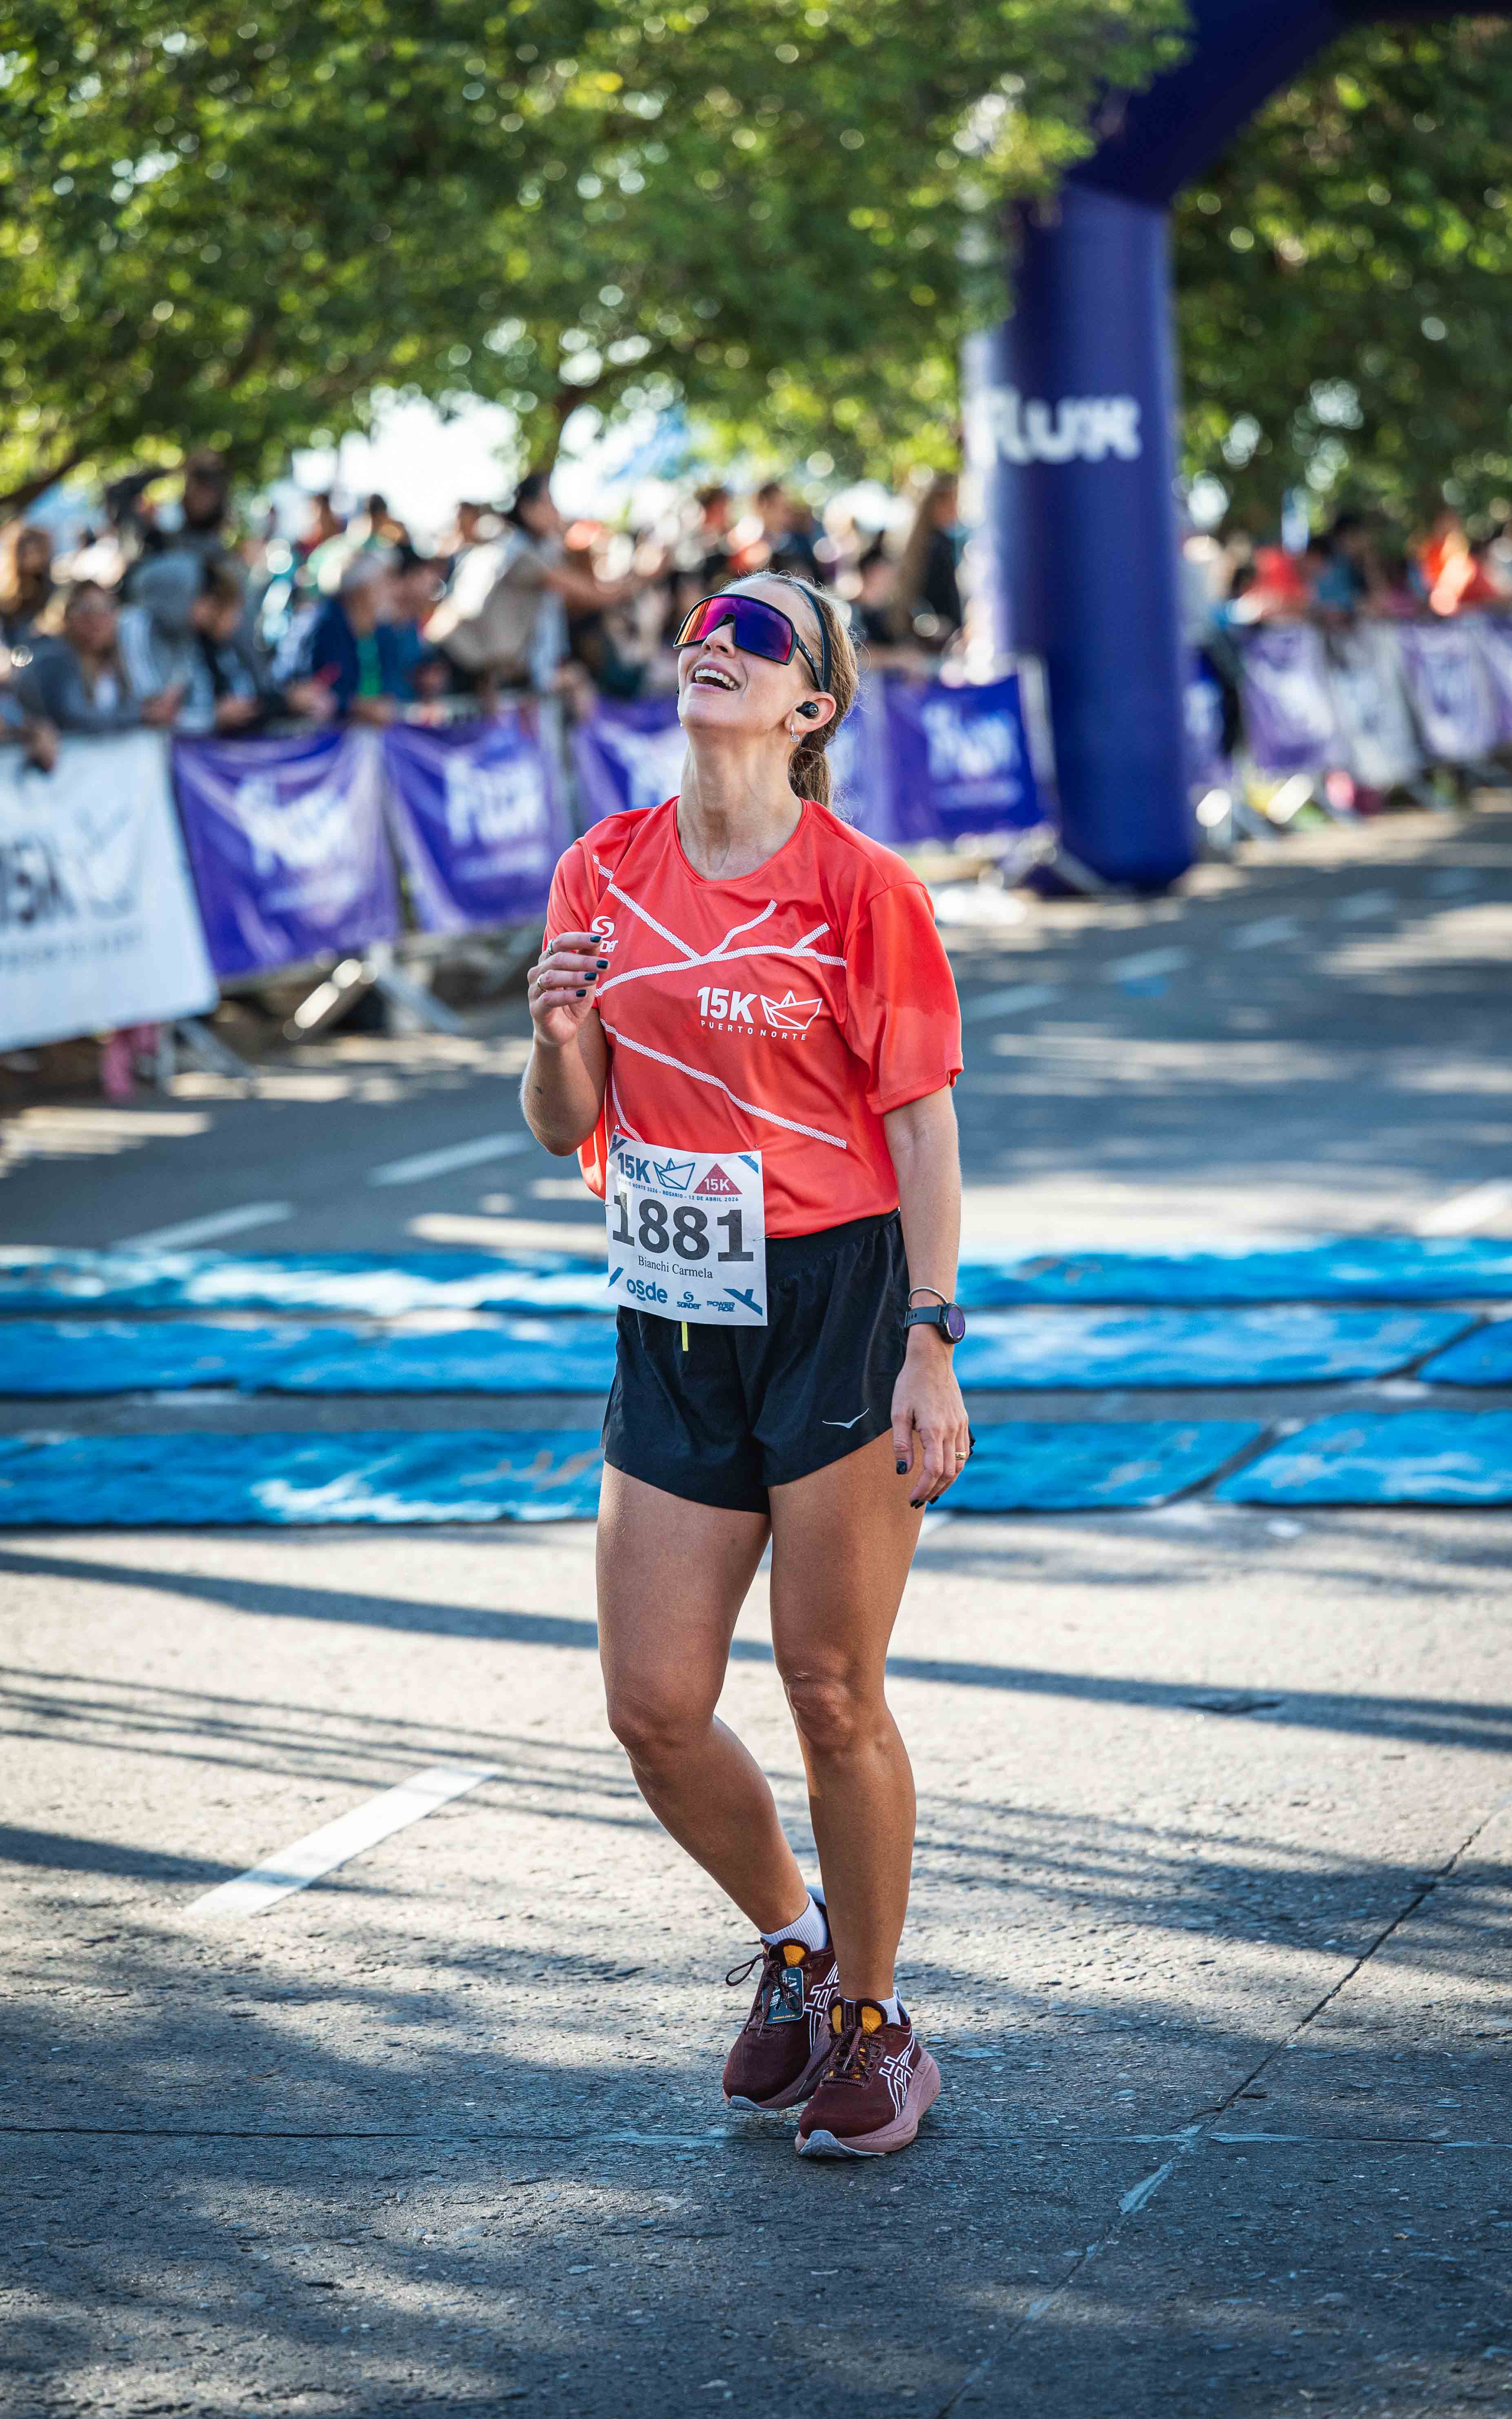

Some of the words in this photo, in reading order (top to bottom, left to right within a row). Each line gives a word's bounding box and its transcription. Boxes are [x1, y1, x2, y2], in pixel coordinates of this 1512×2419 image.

[697, 986, 757, 1024] 15K
[701, 1020, 753, 1034] PUERTO
[760, 1029, 807, 1040] NORTE
[617, 1152, 651, 1184] 15K
[662, 1190, 683, 1198] ROSARIO
[704, 1178, 730, 1191] 15K
[613, 1191, 754, 1262] 1881
[638, 1255, 669, 1272] Bianchi
[672, 1264, 713, 1279] Carmela
[626, 1279, 668, 1304] osde
